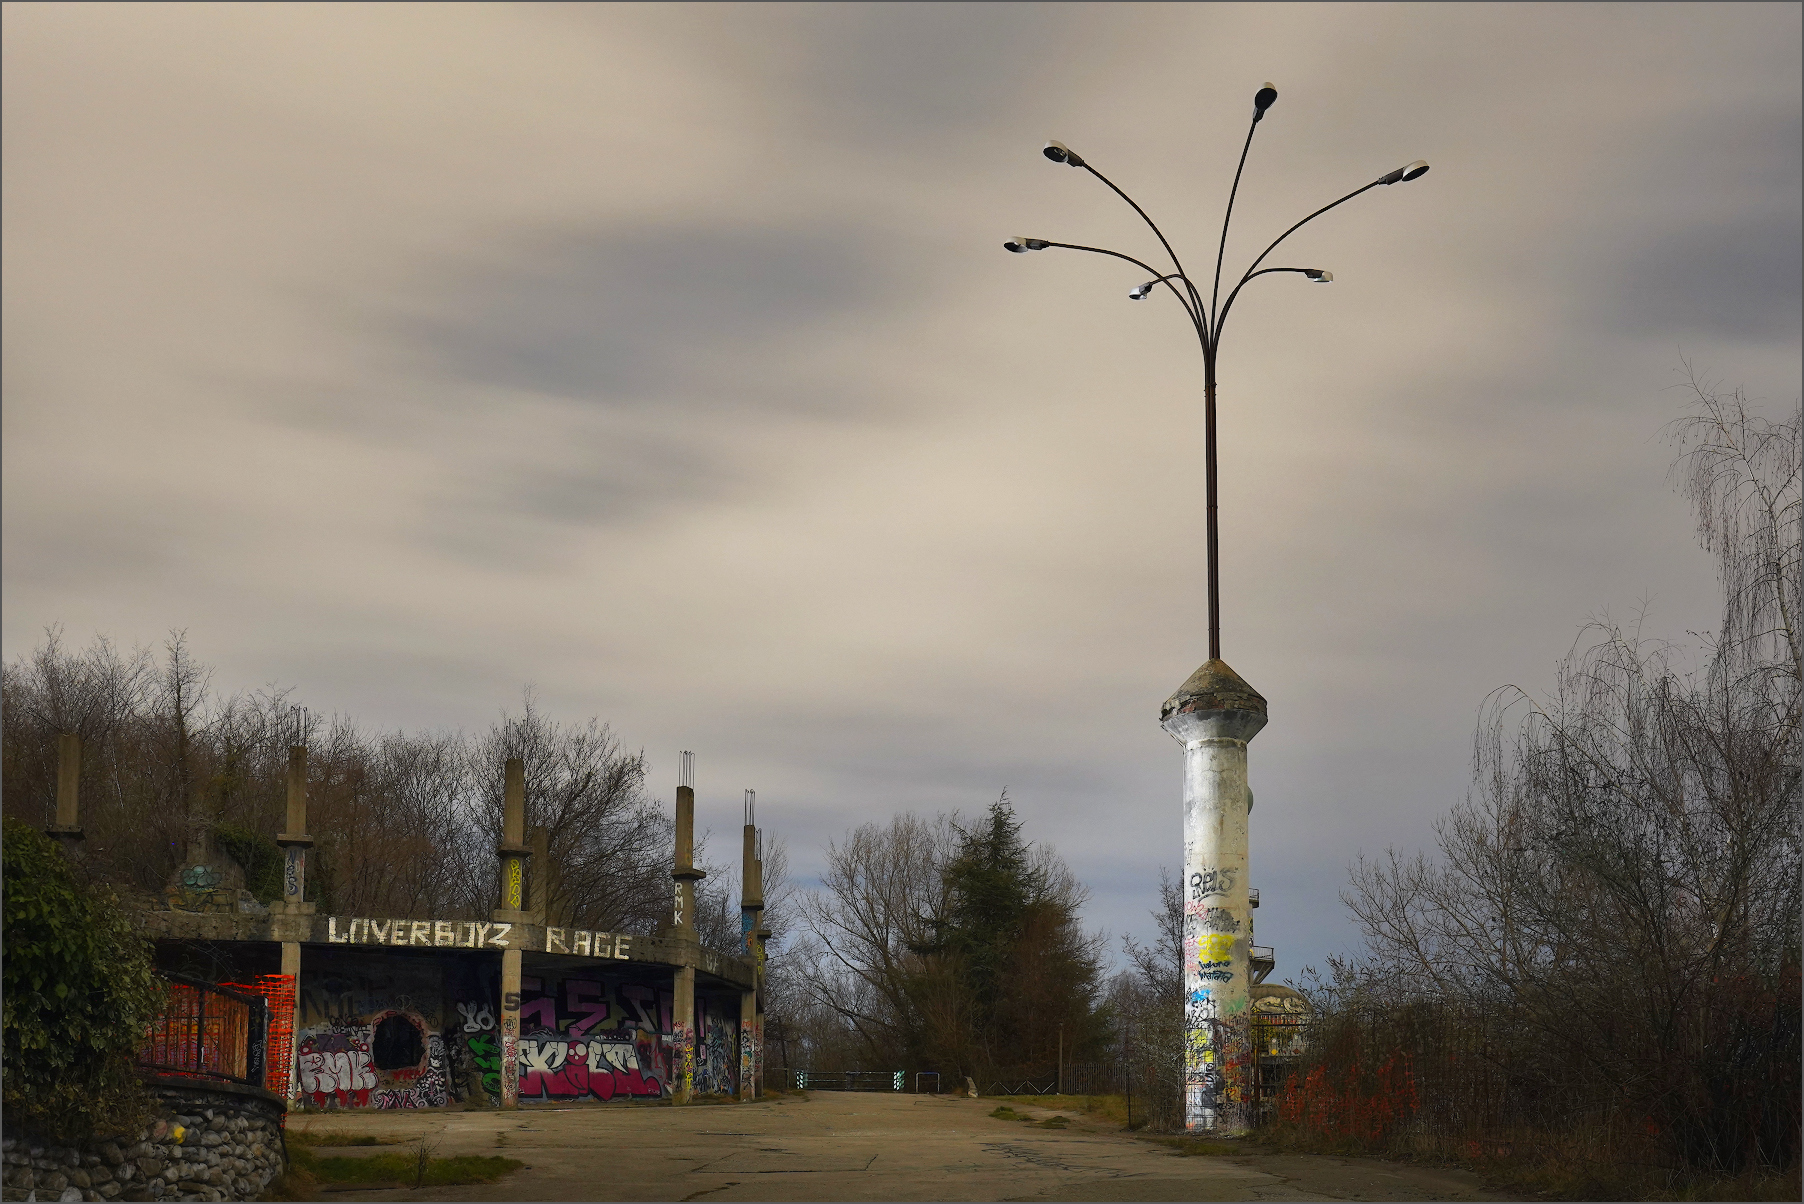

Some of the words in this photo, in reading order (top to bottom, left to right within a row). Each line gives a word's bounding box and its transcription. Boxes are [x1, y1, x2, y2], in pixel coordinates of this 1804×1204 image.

[673, 882, 684, 925] RMK
[327, 916, 513, 949] LOVERBOYZ
[545, 926, 633, 960] RAGE
